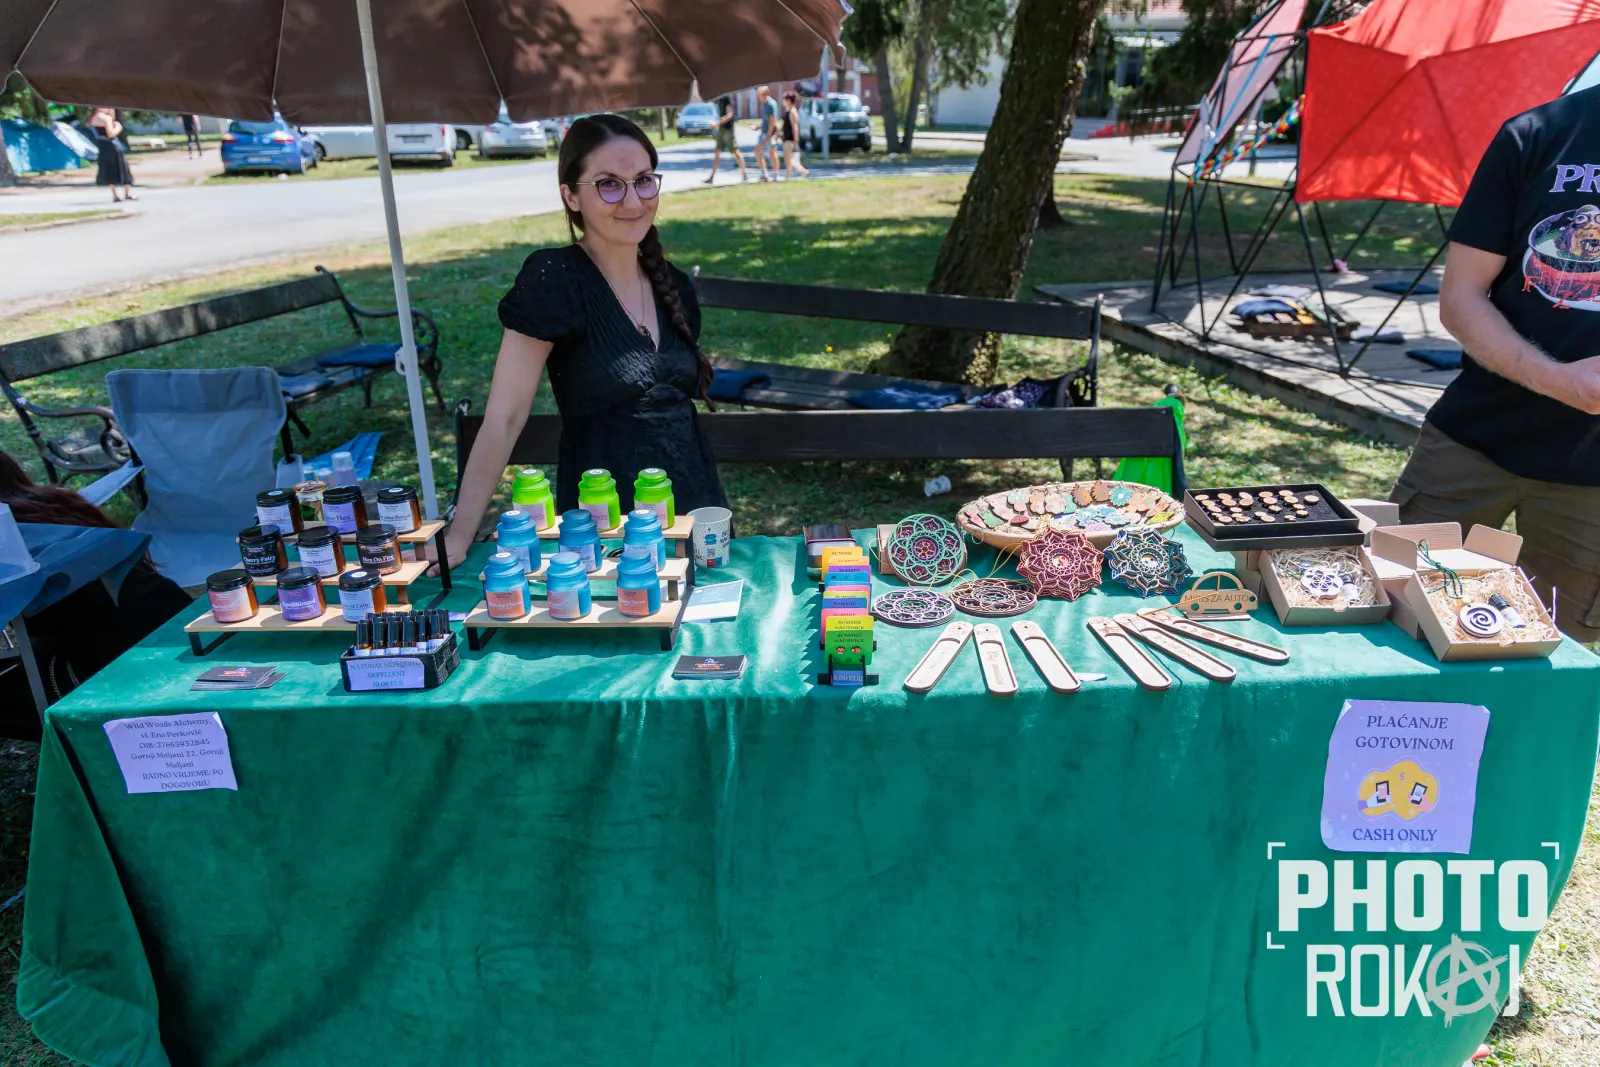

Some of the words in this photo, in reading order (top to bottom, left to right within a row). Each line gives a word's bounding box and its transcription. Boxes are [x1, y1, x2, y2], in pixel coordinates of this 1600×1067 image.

[1210, 594, 1223, 603] ZA
[1223, 594, 1249, 603] AUTO
[366, 670, 406, 678] REPELLENT
[124, 721, 145, 730] Wild
[145, 720, 173, 729] Woods
[1367, 714, 1448, 729] PLAĆANJE
[151, 731, 166, 739] Ena
[1355, 736, 1454, 750] GOTOVINOM
[130, 752, 156, 761] Gornji
[156, 751, 185, 761] Meljani
[199, 748, 224, 758] Gornji
[165, 761, 194, 770] Meljani
[142, 771, 172, 780] RADNO
[172, 769, 212, 779] VRIJEME:
[212, 768, 224, 776] PO
[160, 779, 211, 790] DOGOVORU
[1352, 827, 1395, 842] CASH
[1397, 828, 1438, 842] ONLY
